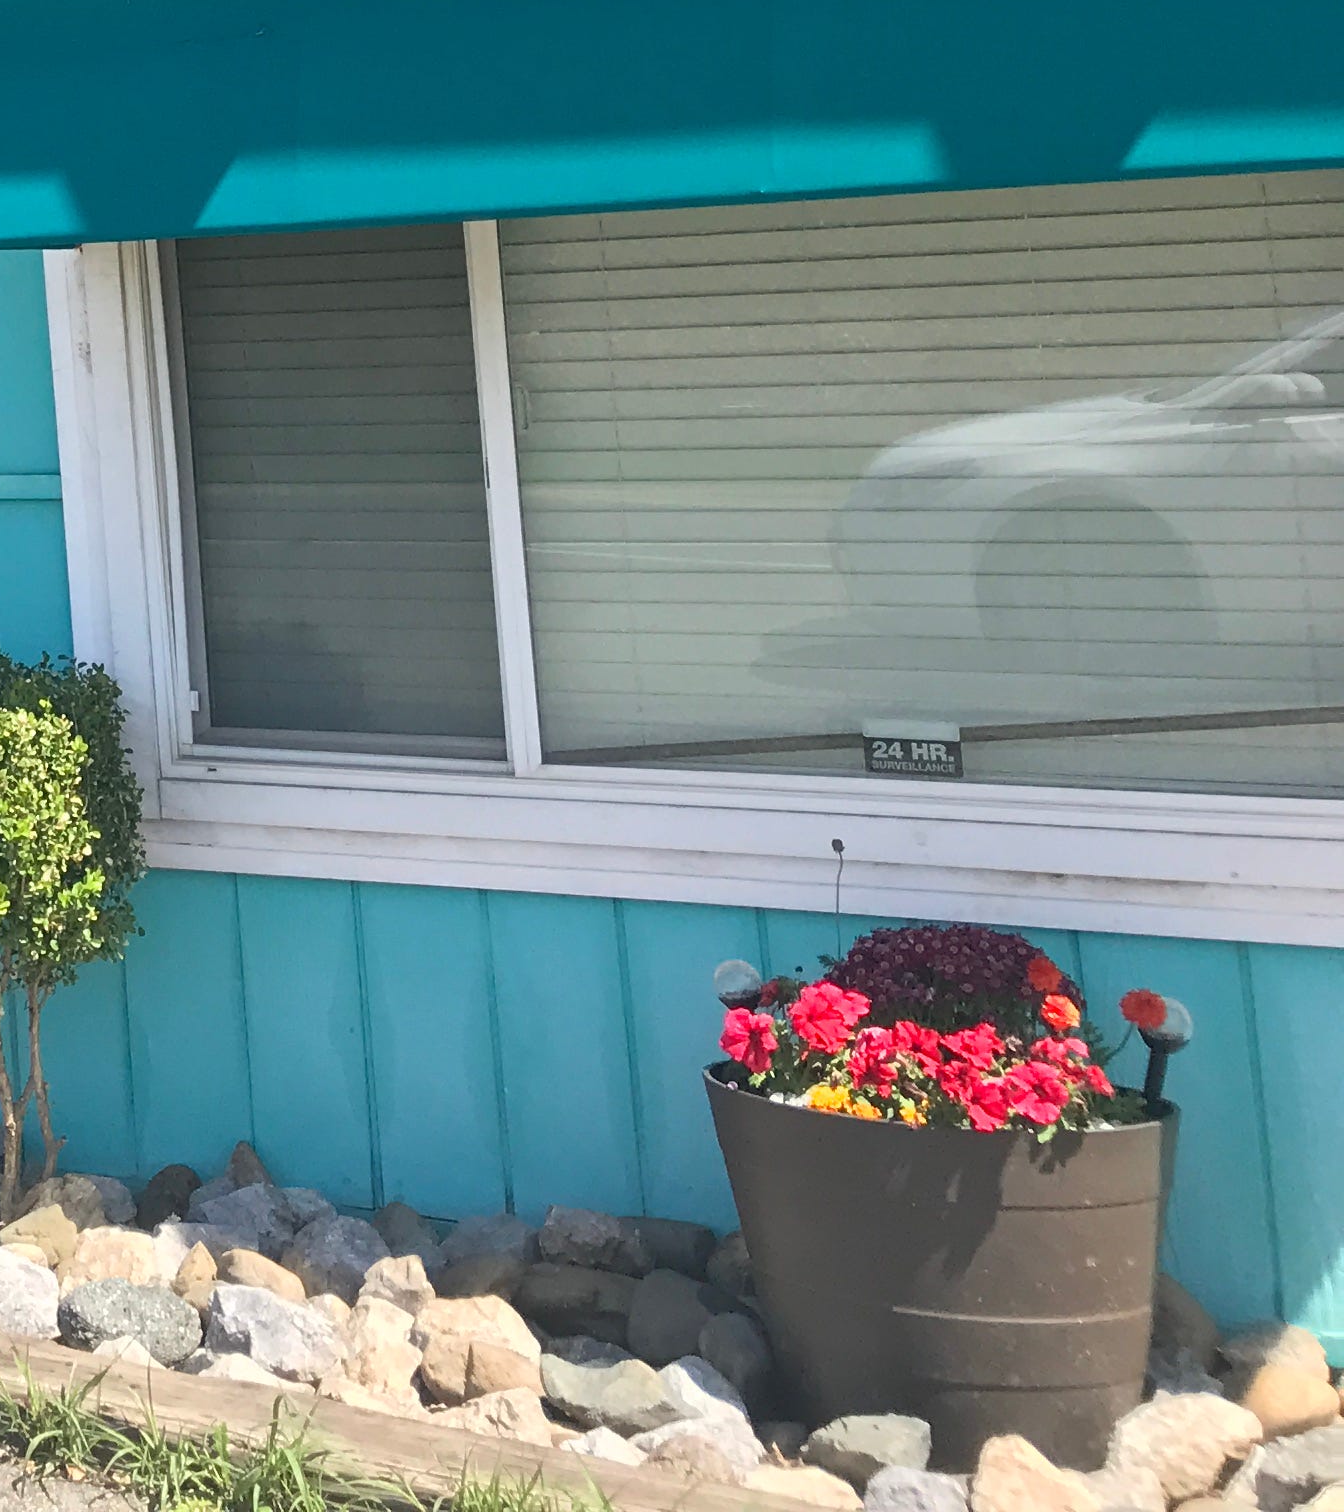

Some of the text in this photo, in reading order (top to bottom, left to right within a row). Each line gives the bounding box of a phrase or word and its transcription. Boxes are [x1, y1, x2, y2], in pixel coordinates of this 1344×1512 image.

[872, 740, 955, 763] 24 HR.
[871, 759, 957, 774] SURVEILLANCE
